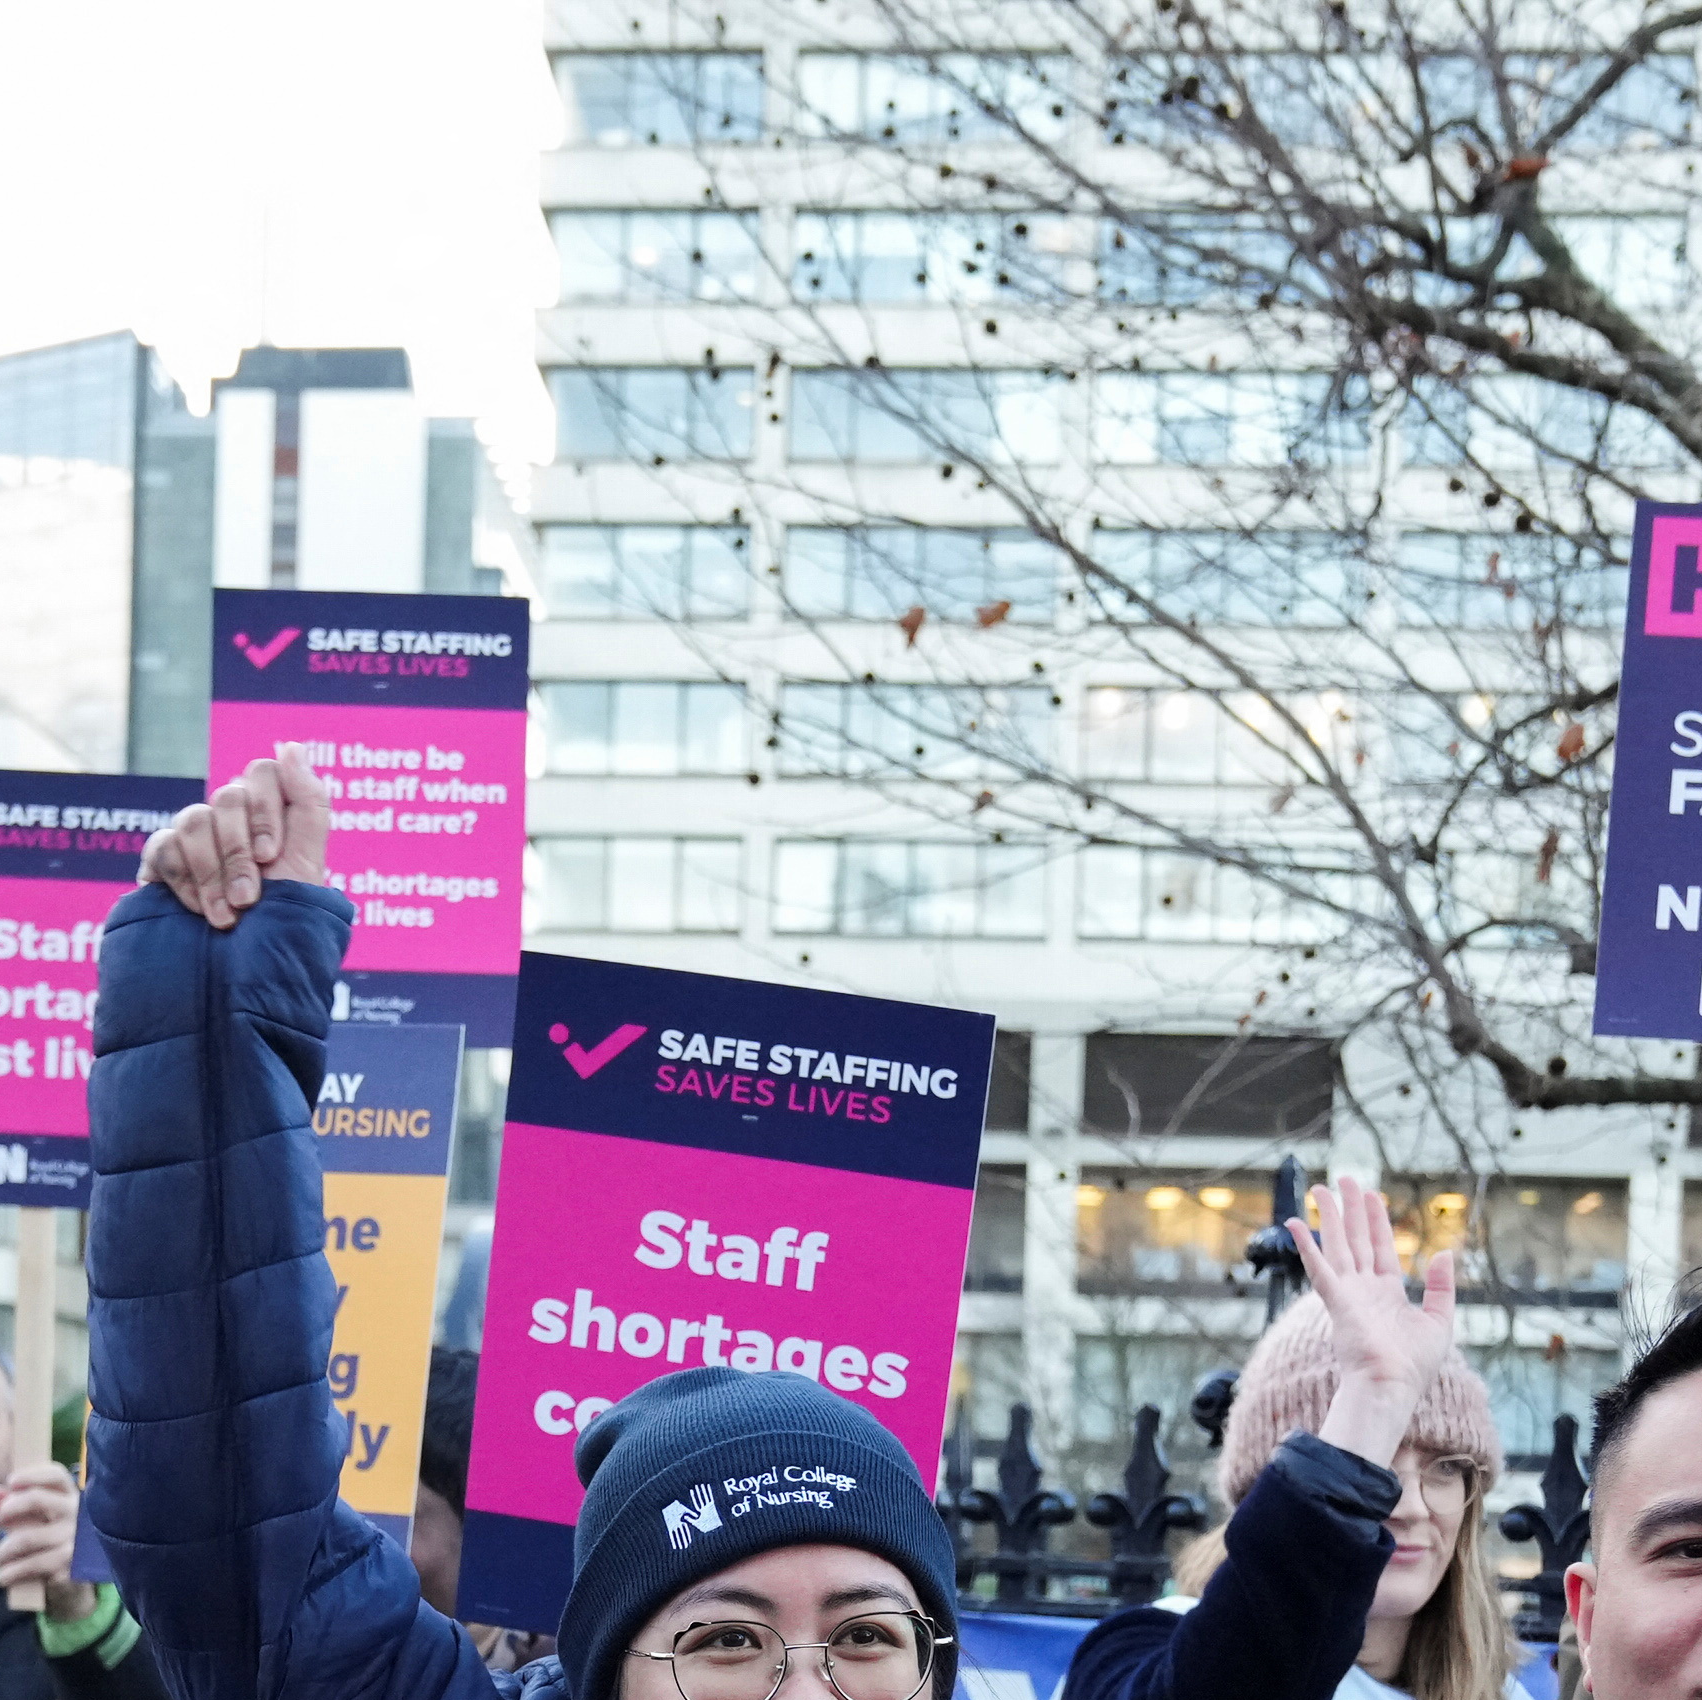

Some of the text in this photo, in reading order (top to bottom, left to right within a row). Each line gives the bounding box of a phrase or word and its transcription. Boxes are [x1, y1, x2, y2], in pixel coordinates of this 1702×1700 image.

[307, 628, 512, 657] SAFE STAFFING
[308, 652, 470, 678] SAVES LIVES
[340, 741, 422, 769] there
[425, 744, 465, 771] be
[347, 776, 419, 801] staff
[422, 777, 507, 804] when
[61, 806, 177, 832] STAFFIN
[397, 810, 478, 835] care?
[350, 868, 498, 902] shortages
[364, 899, 435, 927] lives
[658, 1028, 959, 1100] SAFE STAFFING
[317, 1072, 364, 1104] AY
[655, 1065, 893, 1124] SAVES LIVES
[311, 1107, 431, 1138] URSING
[633, 1209, 830, 1292] Staff
[723, 1465, 857, 1495] Royal College
[731, 1486, 834, 1517] of Nursing
